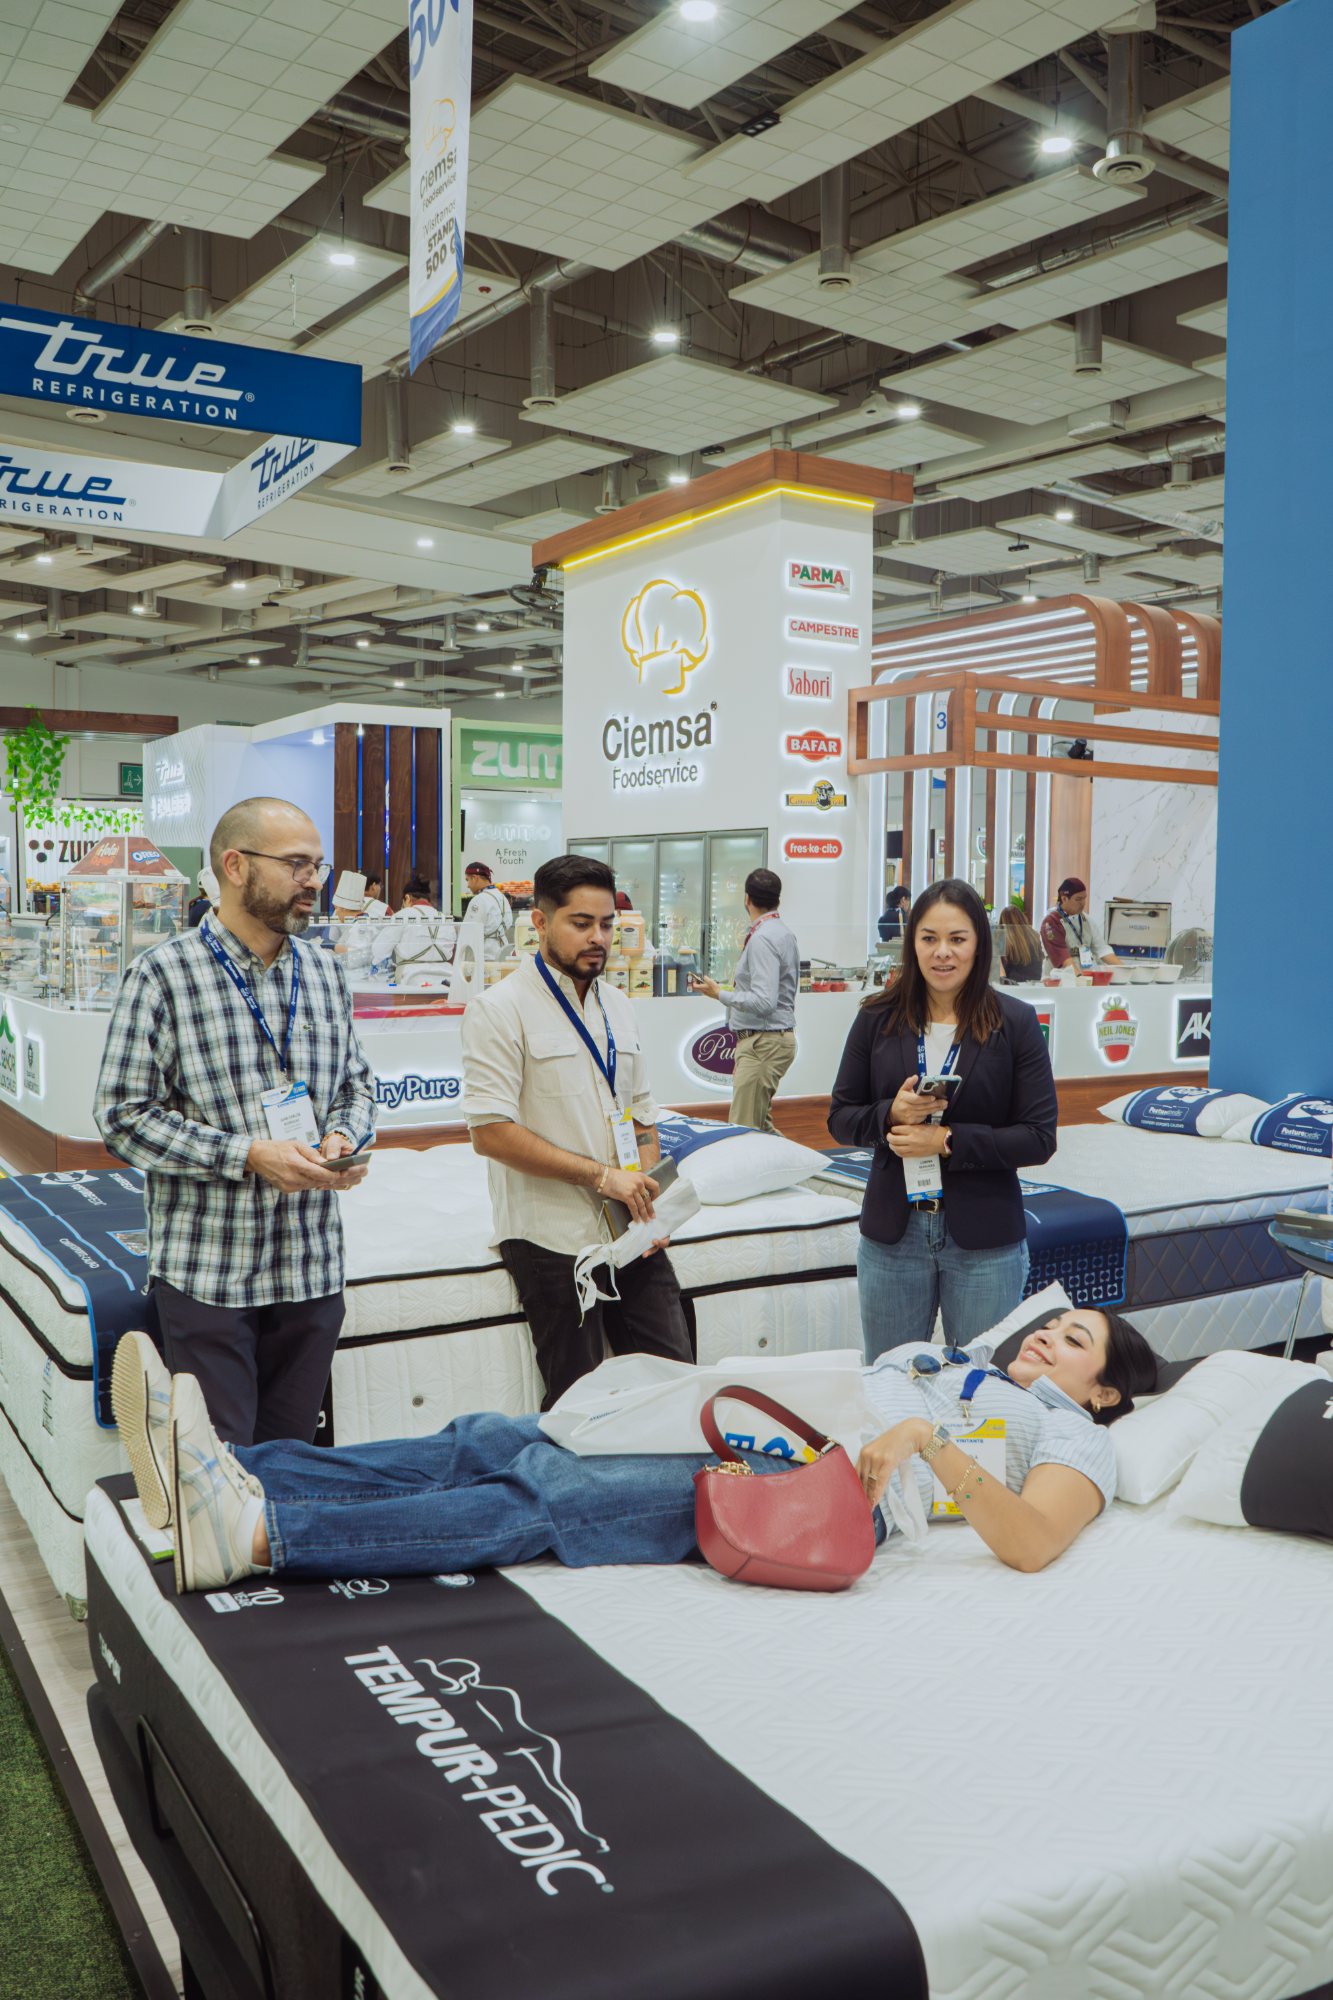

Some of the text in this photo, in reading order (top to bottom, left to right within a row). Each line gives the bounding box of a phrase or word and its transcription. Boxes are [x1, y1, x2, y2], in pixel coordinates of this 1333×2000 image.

[428, 217, 455, 253] STAND
[0, 317, 243, 401] true
[32, 377, 237, 421] REFRIGERATION
[251, 438, 316, 493] true
[257, 462, 315, 509] REFRIGERATION
[791, 562, 844, 585] PARMA
[790, 621, 859, 639] CAMPESTRE
[789, 668, 830, 697] Sabori
[602, 712, 712, 761] Ciemsa
[790, 738, 837, 752] BAFAR
[612, 761, 698, 789] Foodservice
[498, 857, 524, 865] Touch
[503, 849, 527, 857] Fresh
[1115, 1024, 1136, 1037] JONES
[344, 1645, 607, 1896] TEMPUR-PEDIC
